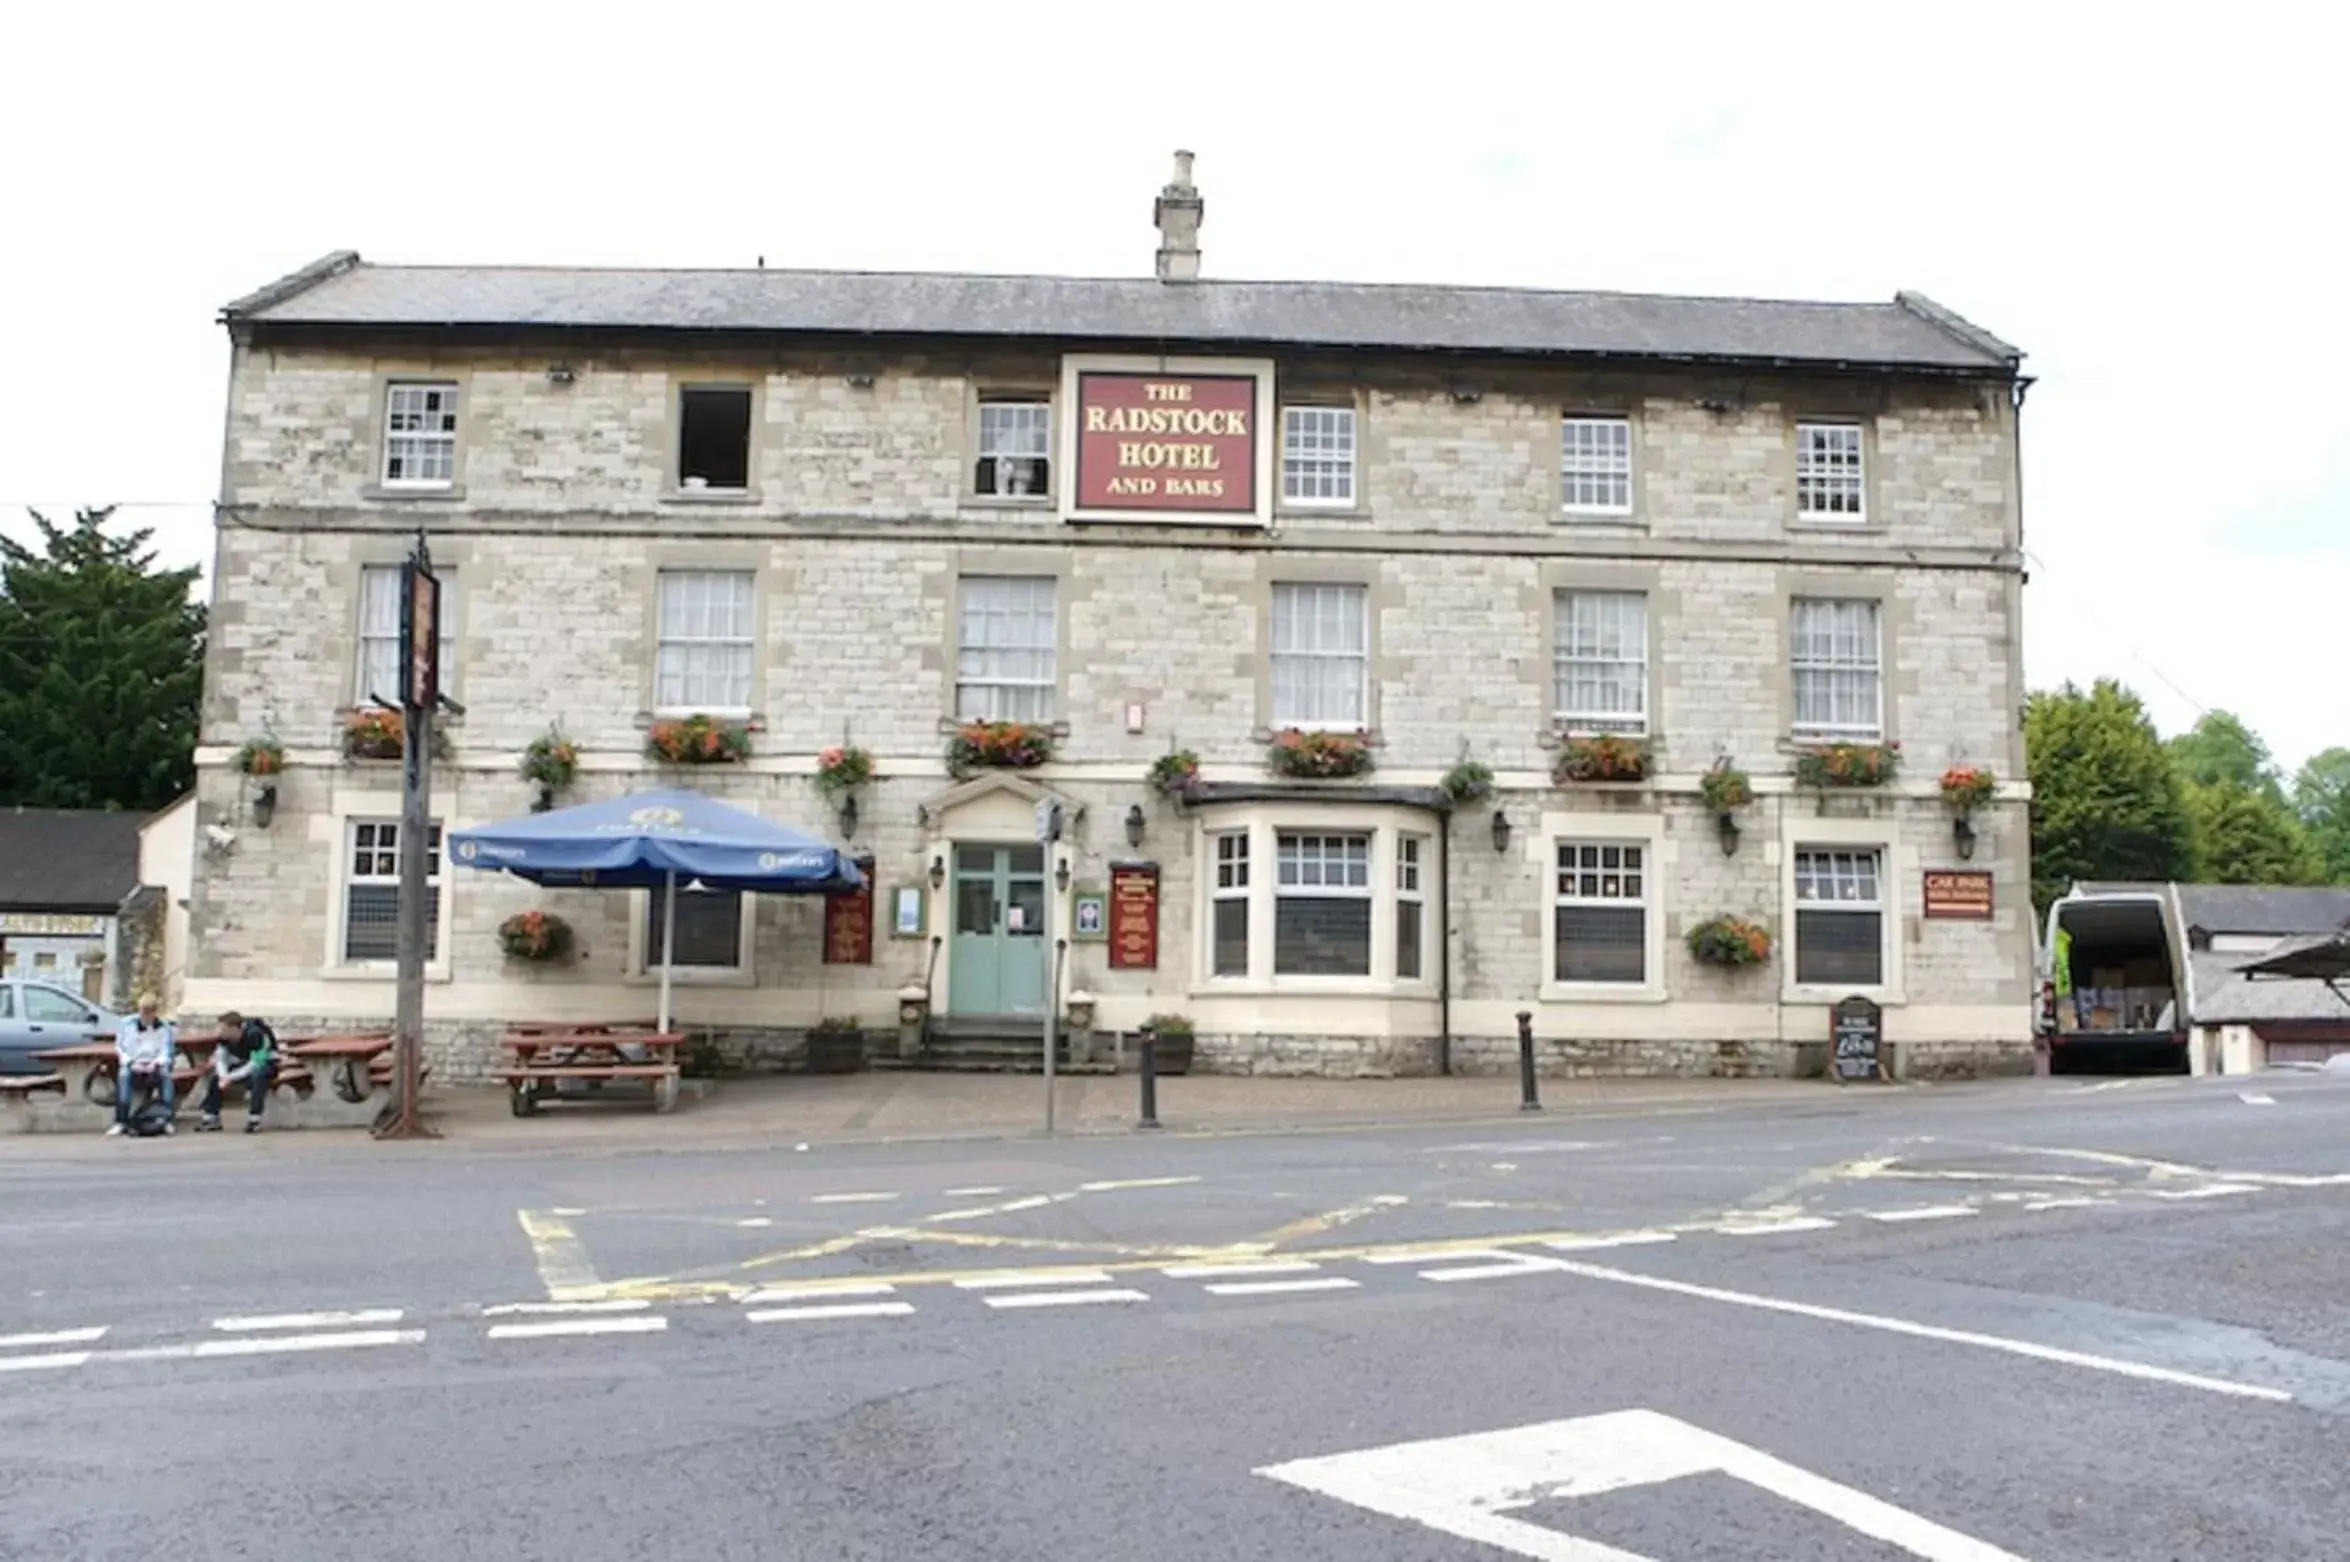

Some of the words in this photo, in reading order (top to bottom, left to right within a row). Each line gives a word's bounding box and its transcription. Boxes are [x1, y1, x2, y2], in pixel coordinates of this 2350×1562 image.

[1144, 384, 1192, 401] THE
[1086, 407, 1247, 435] RADSTOCK
[1118, 442, 1220, 470] HOTEL
[1107, 477, 1156, 494] AND
[1165, 478, 1225, 496] BARS
